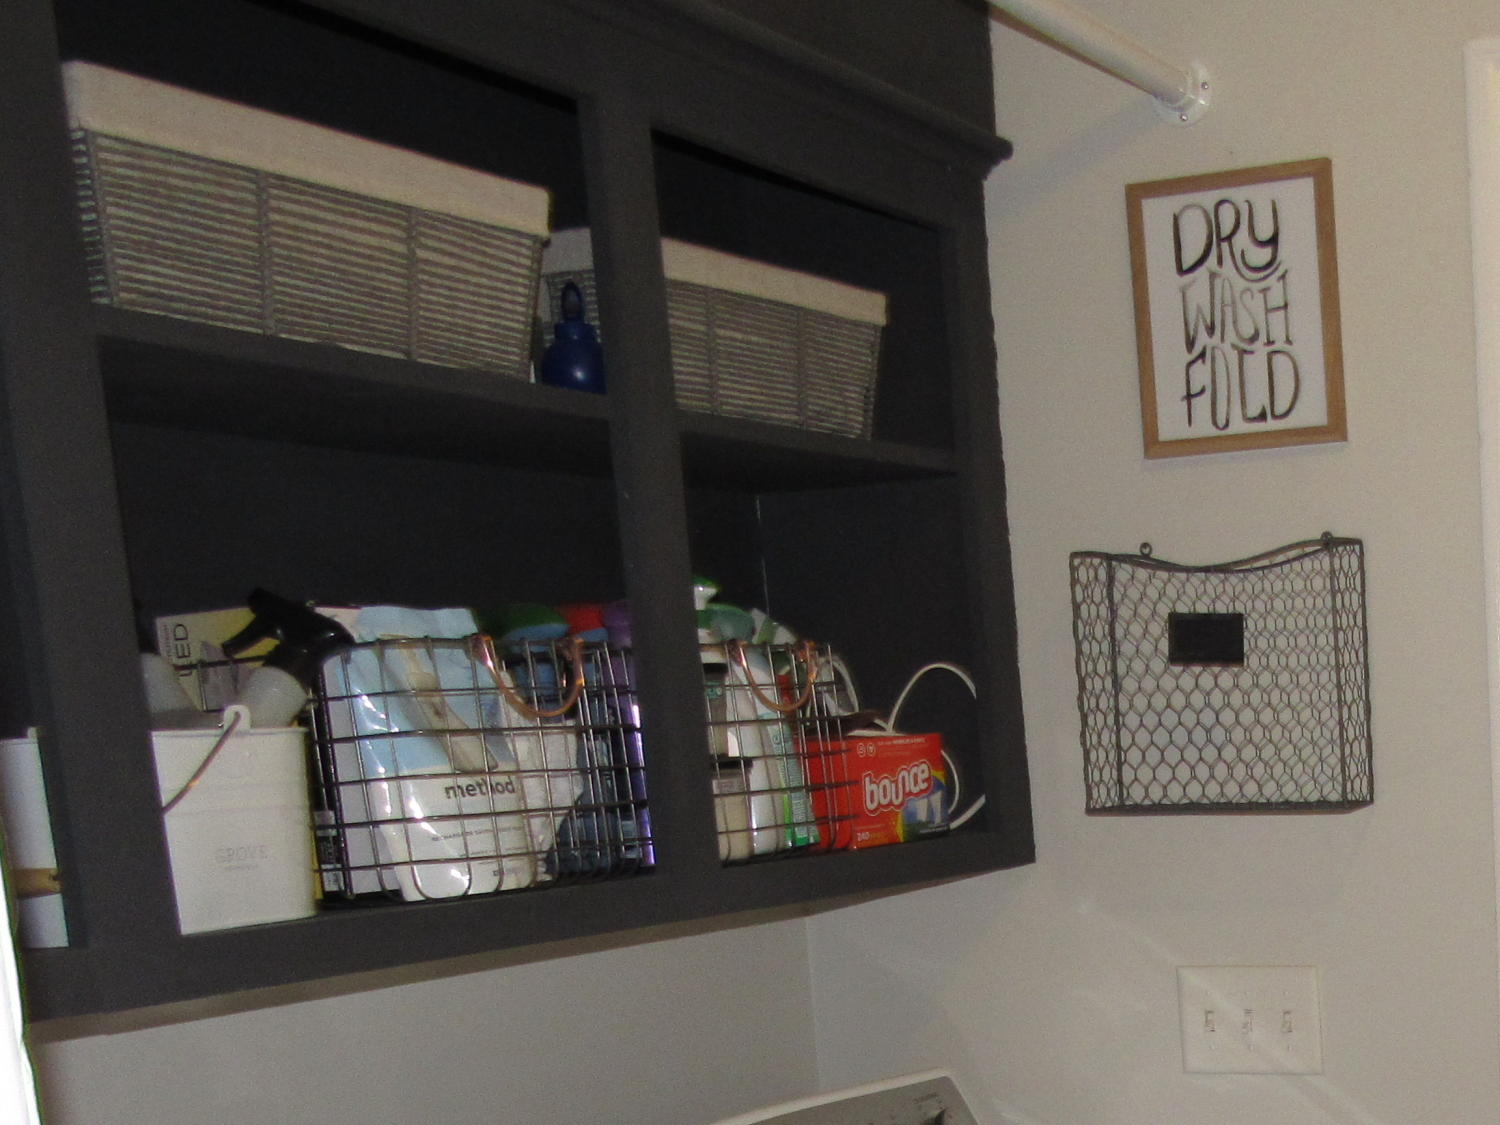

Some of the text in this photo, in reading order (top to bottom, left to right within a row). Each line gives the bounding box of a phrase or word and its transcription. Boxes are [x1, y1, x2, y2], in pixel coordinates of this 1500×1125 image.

[1172, 199, 1282, 282] DRY
[1178, 268, 1294, 354] WASH
[1180, 343, 1300, 431] FOLD
[863, 762, 931, 812] bounce
